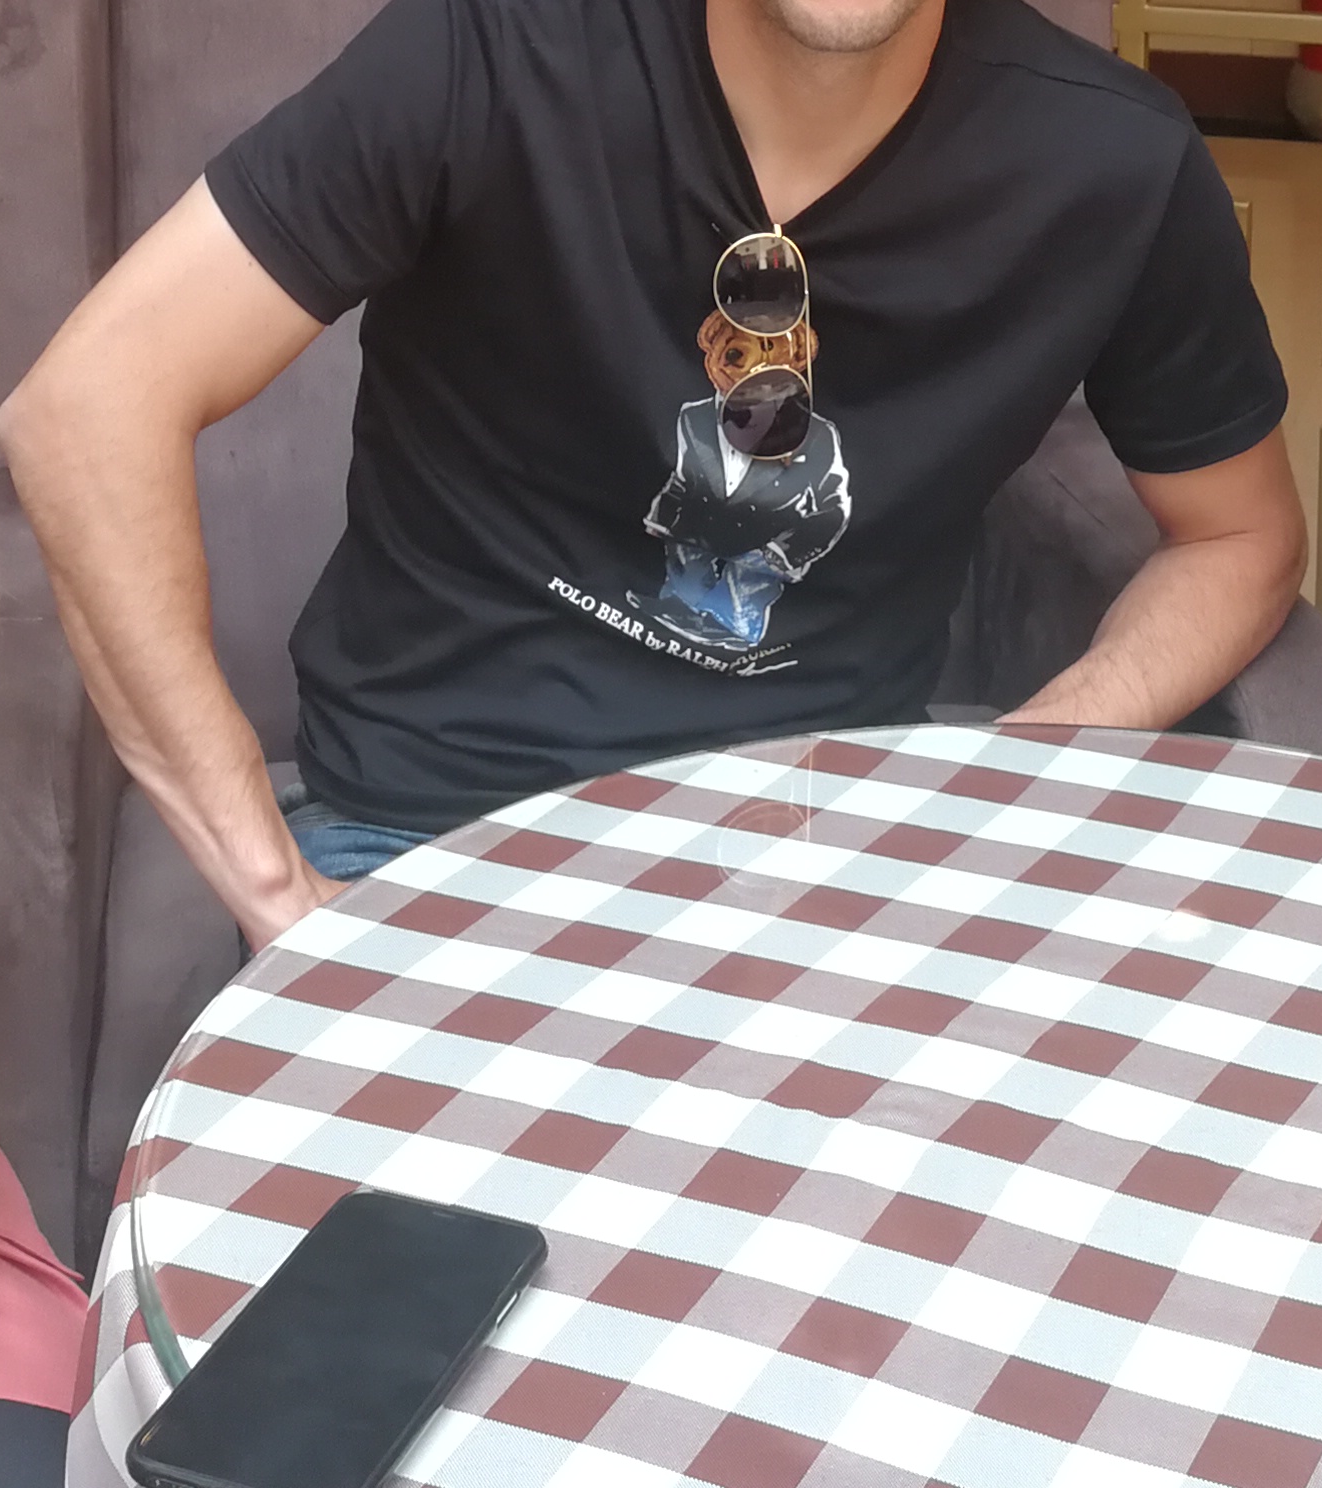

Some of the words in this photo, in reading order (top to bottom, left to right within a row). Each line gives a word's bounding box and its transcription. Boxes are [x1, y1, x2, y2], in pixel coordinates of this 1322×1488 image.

[547, 576, 596, 612] POLO
[594, 600, 644, 641] BEAR
[645, 631, 666, 651] by
[665, 639, 729, 674] RALPH
